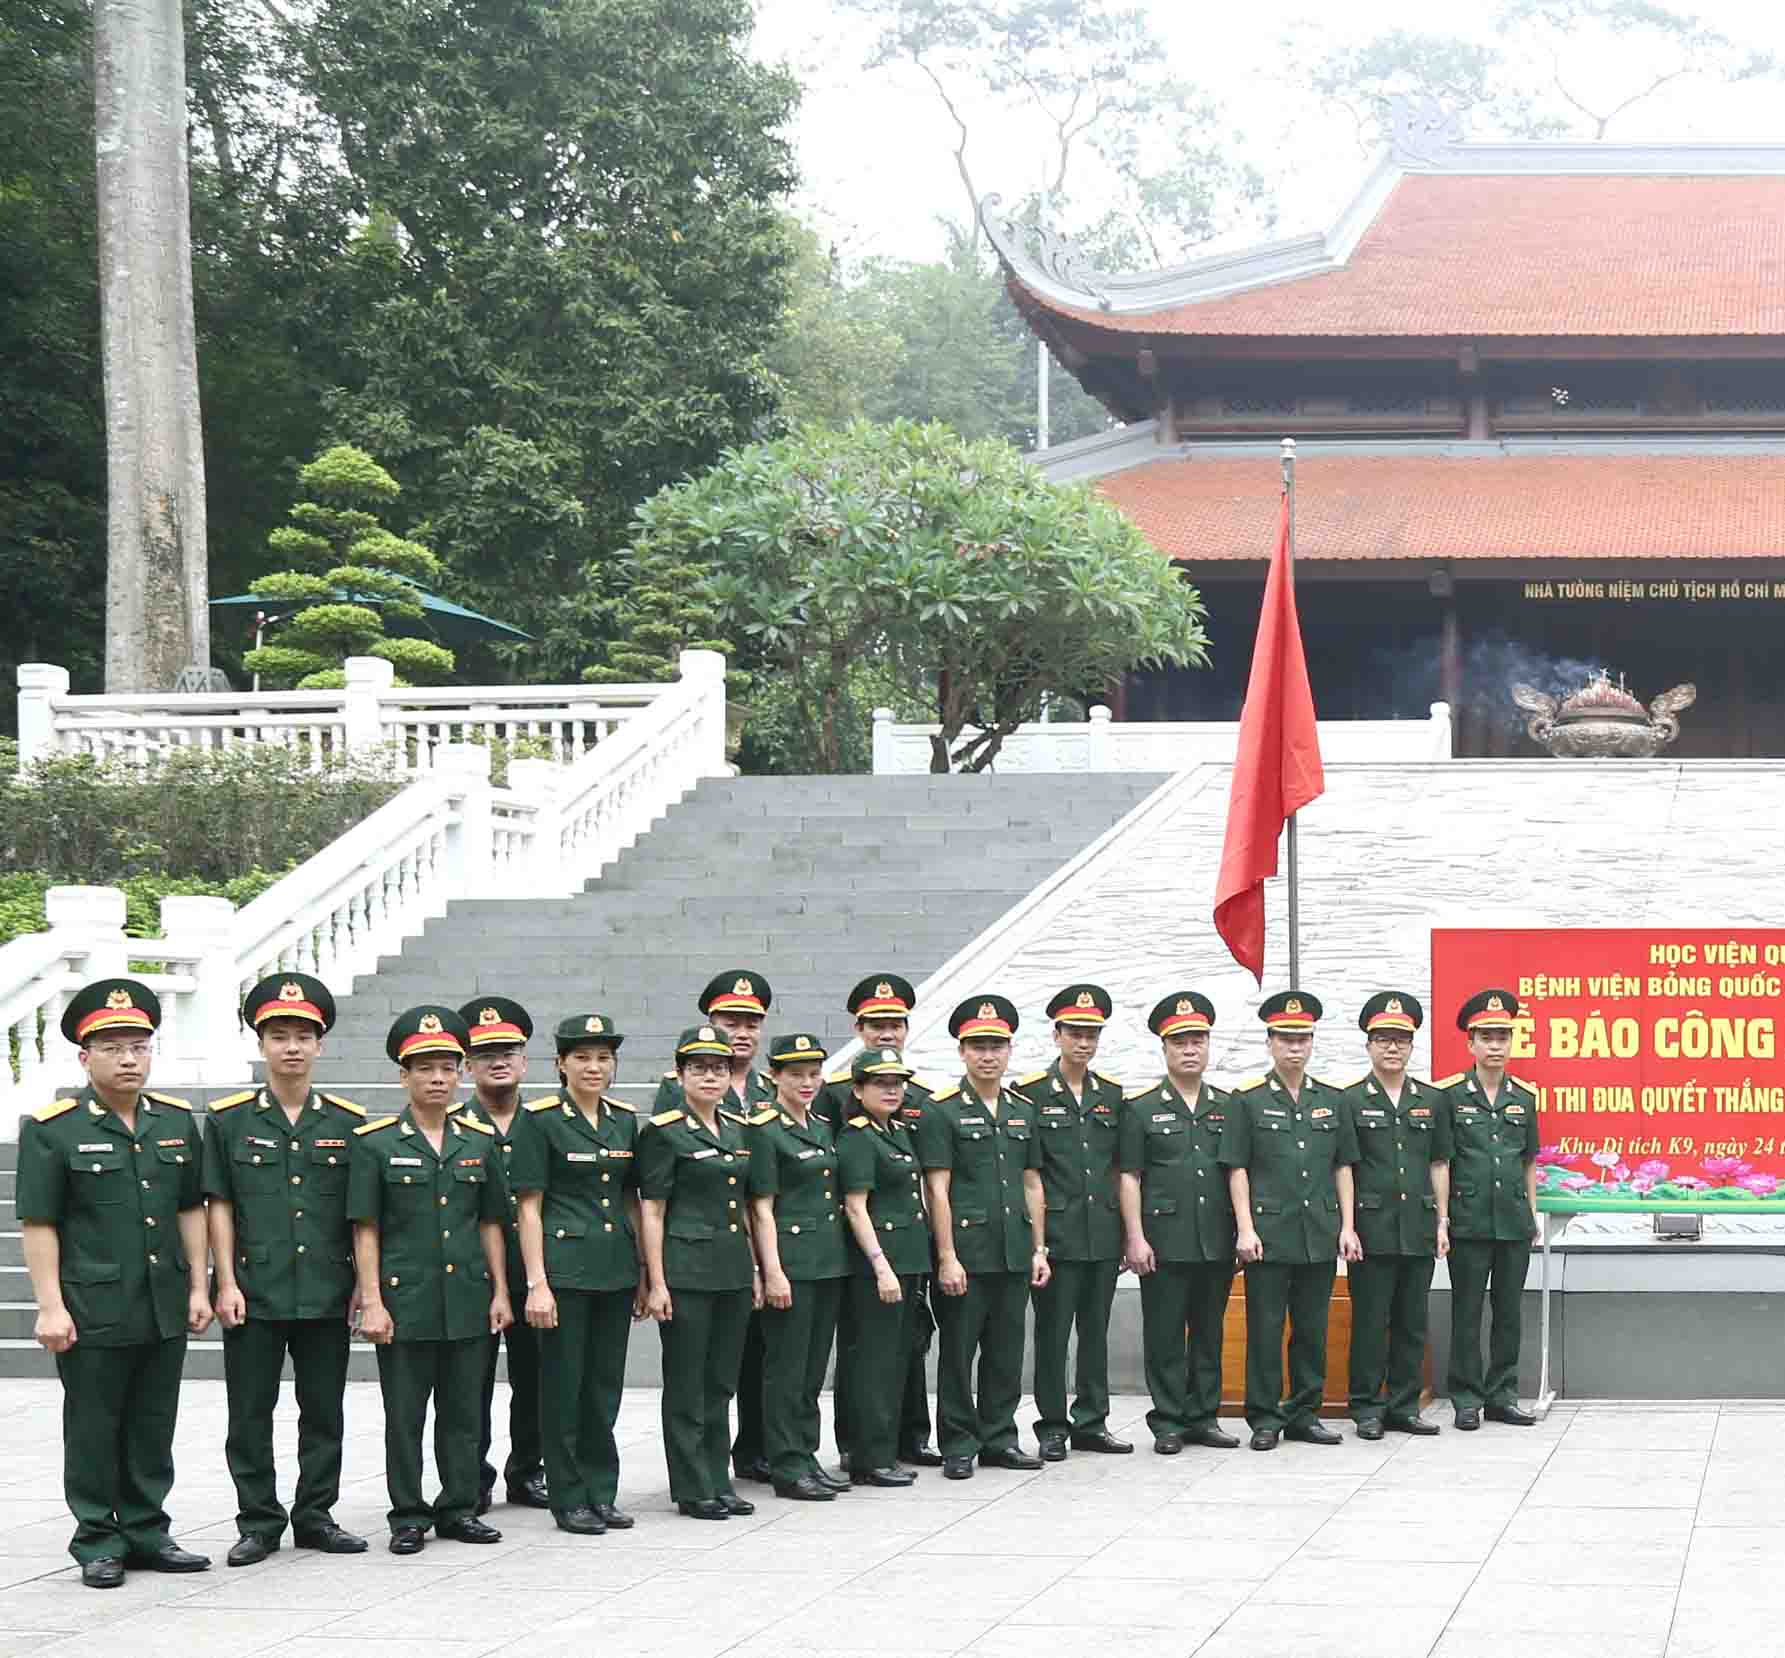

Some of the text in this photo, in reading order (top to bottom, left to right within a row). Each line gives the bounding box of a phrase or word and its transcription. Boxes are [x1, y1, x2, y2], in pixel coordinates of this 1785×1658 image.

[1524, 580, 1553, 599] NHÀ
[1649, 579, 1679, 599] CHỦ
[1682, 580, 1716, 602] TỊCH
[1745, 580, 1769, 599] CHÍ
[1649, 944, 1697, 968] HỌC
[1704, 940, 1757, 968] VIỆN
[1519, 974, 1581, 1001] BỆNH
[1588, 974, 1641, 1001] VIỆN
[1648, 971, 1712, 997] BỎNG
[1719, 970, 1781, 998] QUỐC
[1510, 1001, 1536, 1058] Ễ
[1549, 1009, 1640, 1058] BÁO
[1654, 1009, 1775, 1059] CÔNG
[1553, 1087, 1586, 1113] THI
[1592, 1087, 1635, 1113] ĐUA
[1641, 1078, 1708, 1116] QUYẾT
[1713, 1077, 1785, 1113] THẮNG
[1557, 1136, 1597, 1155] Khu
[1601, 1136, 1624, 1155] Di
[1628, 1136, 1662, 1155] tích
[1667, 1136, 1698, 1157] K9,
[1703, 1137, 1748, 1159] ngày
[1753, 1137, 1775, 1155] 24
